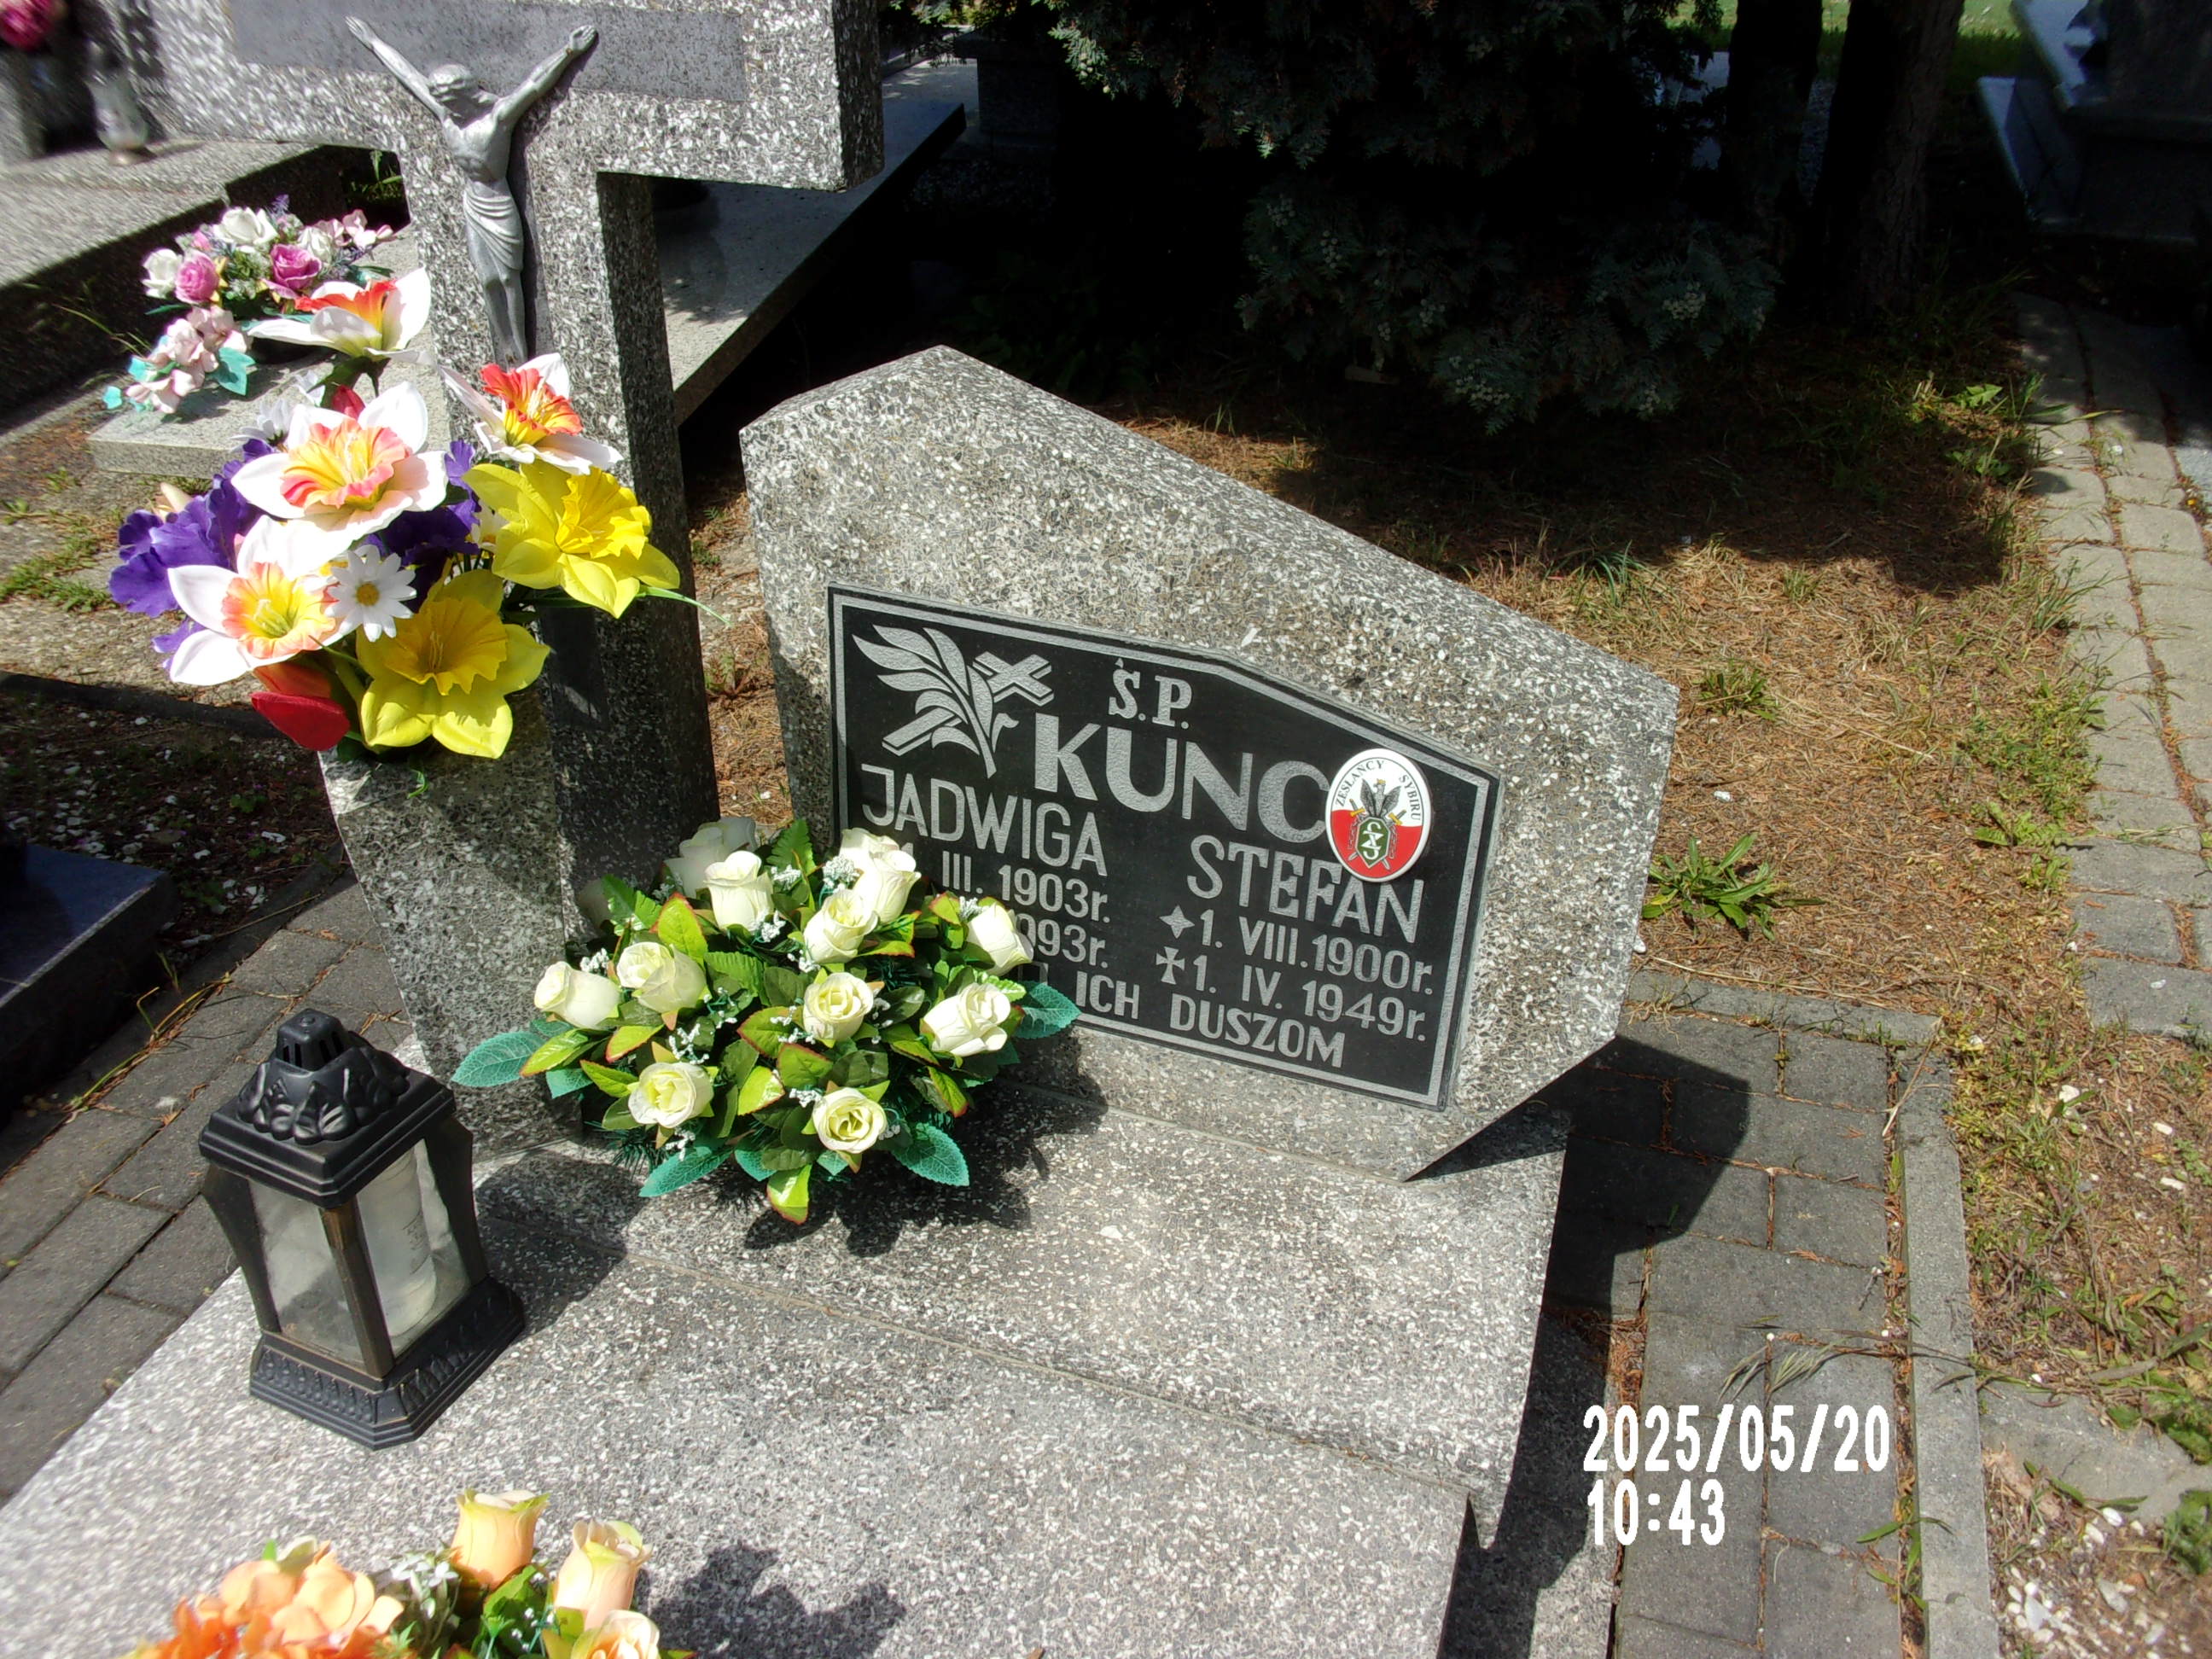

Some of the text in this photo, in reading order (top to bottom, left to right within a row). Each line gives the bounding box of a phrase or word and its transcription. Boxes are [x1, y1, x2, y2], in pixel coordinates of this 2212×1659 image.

[861, 763, 1108, 876] JADWIGA
[1034, 713, 1330, 842] KUNC
[1399, 774, 1422, 822] SYBIRU
[998, 864, 1109, 923] 1903r.
[1187, 835, 1424, 943] STEFAN
[1074, 971, 1139, 1021] ICH
[1170, 992, 1346, 1068] DUSZOM
[1242, 965, 1283, 1009] IV.
[1302, 981, 1425, 1041] 1949r.
